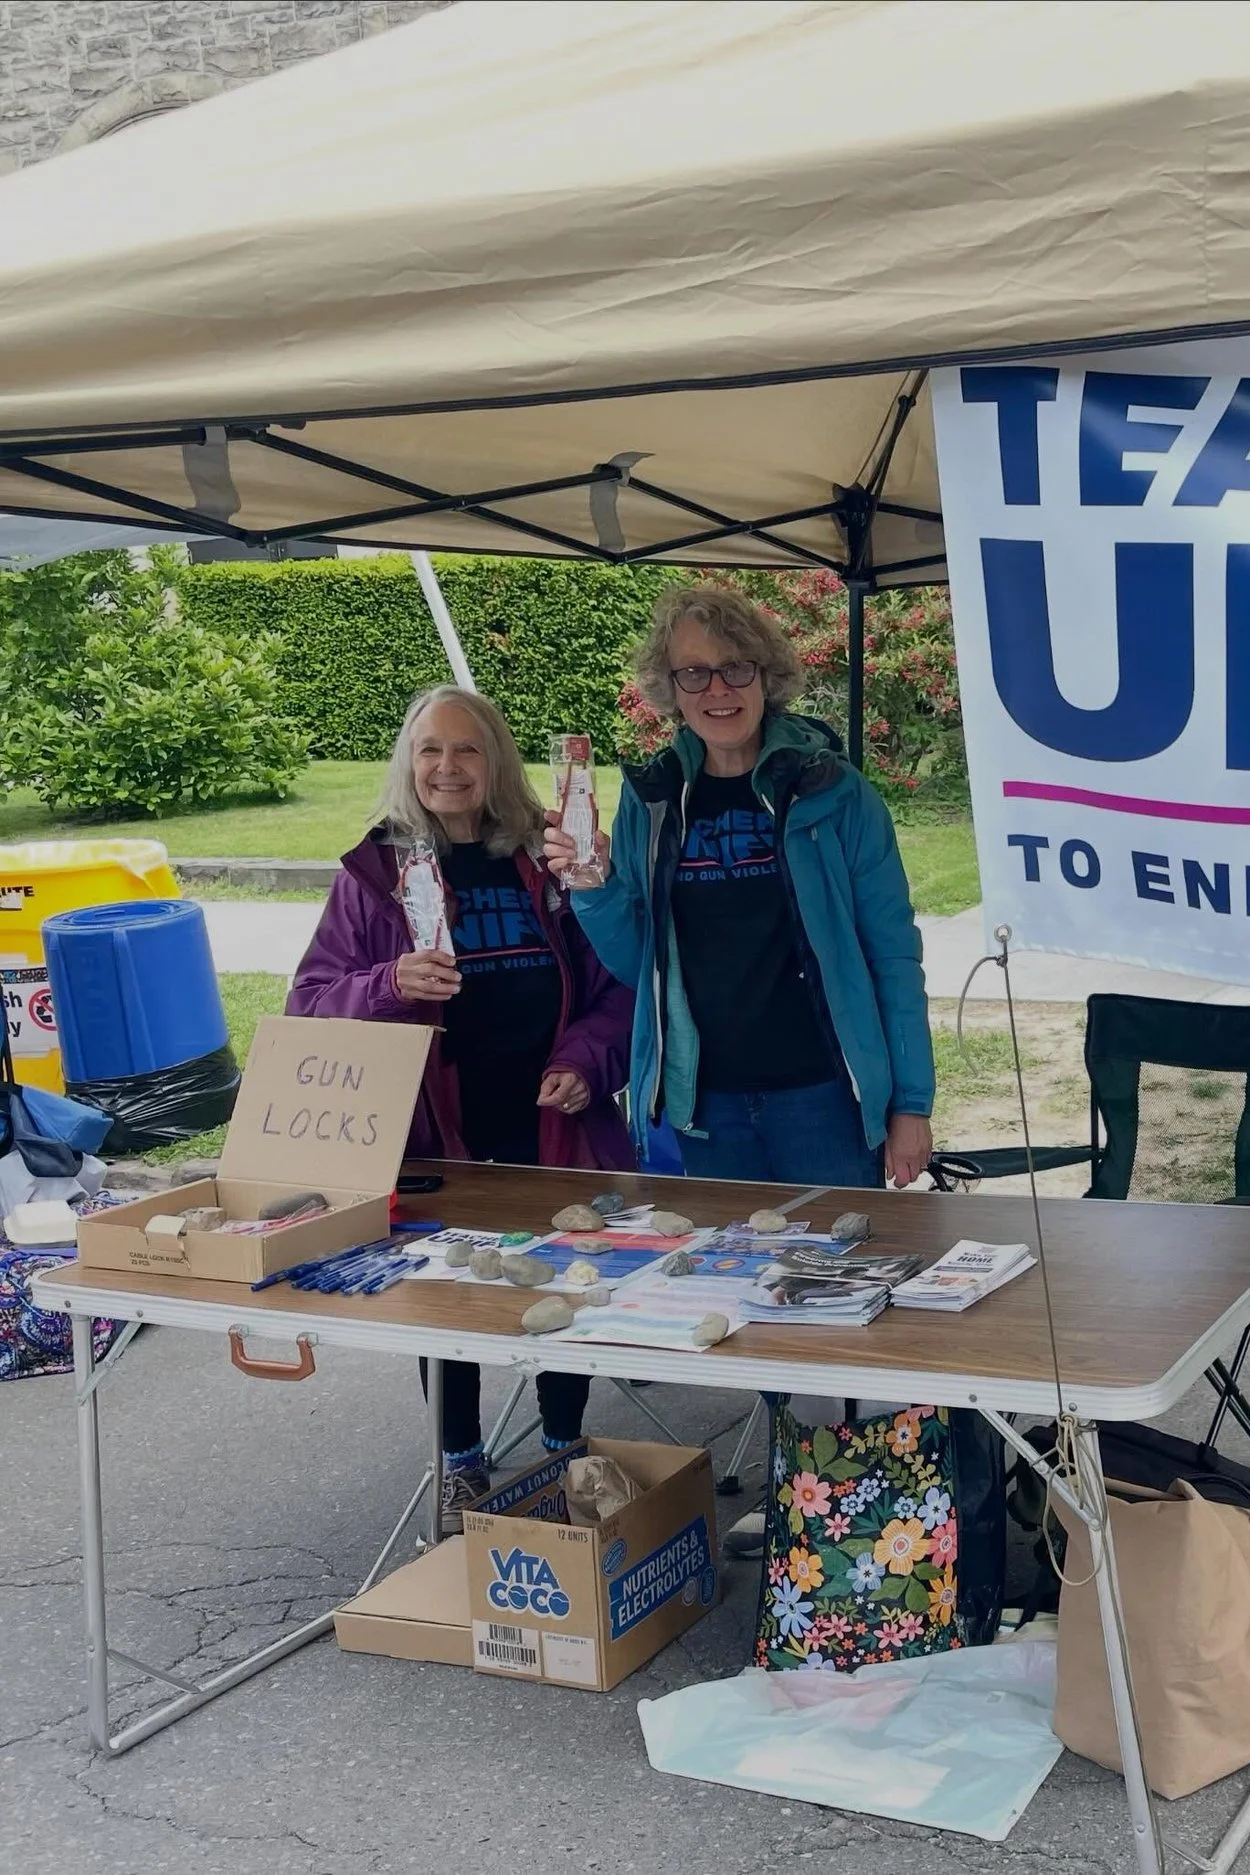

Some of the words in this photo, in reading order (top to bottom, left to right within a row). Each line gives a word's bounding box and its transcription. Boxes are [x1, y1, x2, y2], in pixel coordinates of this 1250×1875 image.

[699, 869, 727, 881] GUN
[1007, 834, 1101, 889] TO
[461, 959, 497, 975] GUN
[296, 1055, 365, 1092] GUN
[262, 1102, 378, 1147] LOCKS
[557, 1528, 566, 1541] 12
[567, 1530, 589, 1543] UNITS
[489, 1546, 562, 1591] VITA
[622, 1534, 690, 1601] NUTRIENTS
[690, 1529, 699, 1549] &
[488, 1580, 571, 1618] COCO
[617, 1544, 705, 1628] ELECTROLYTES
